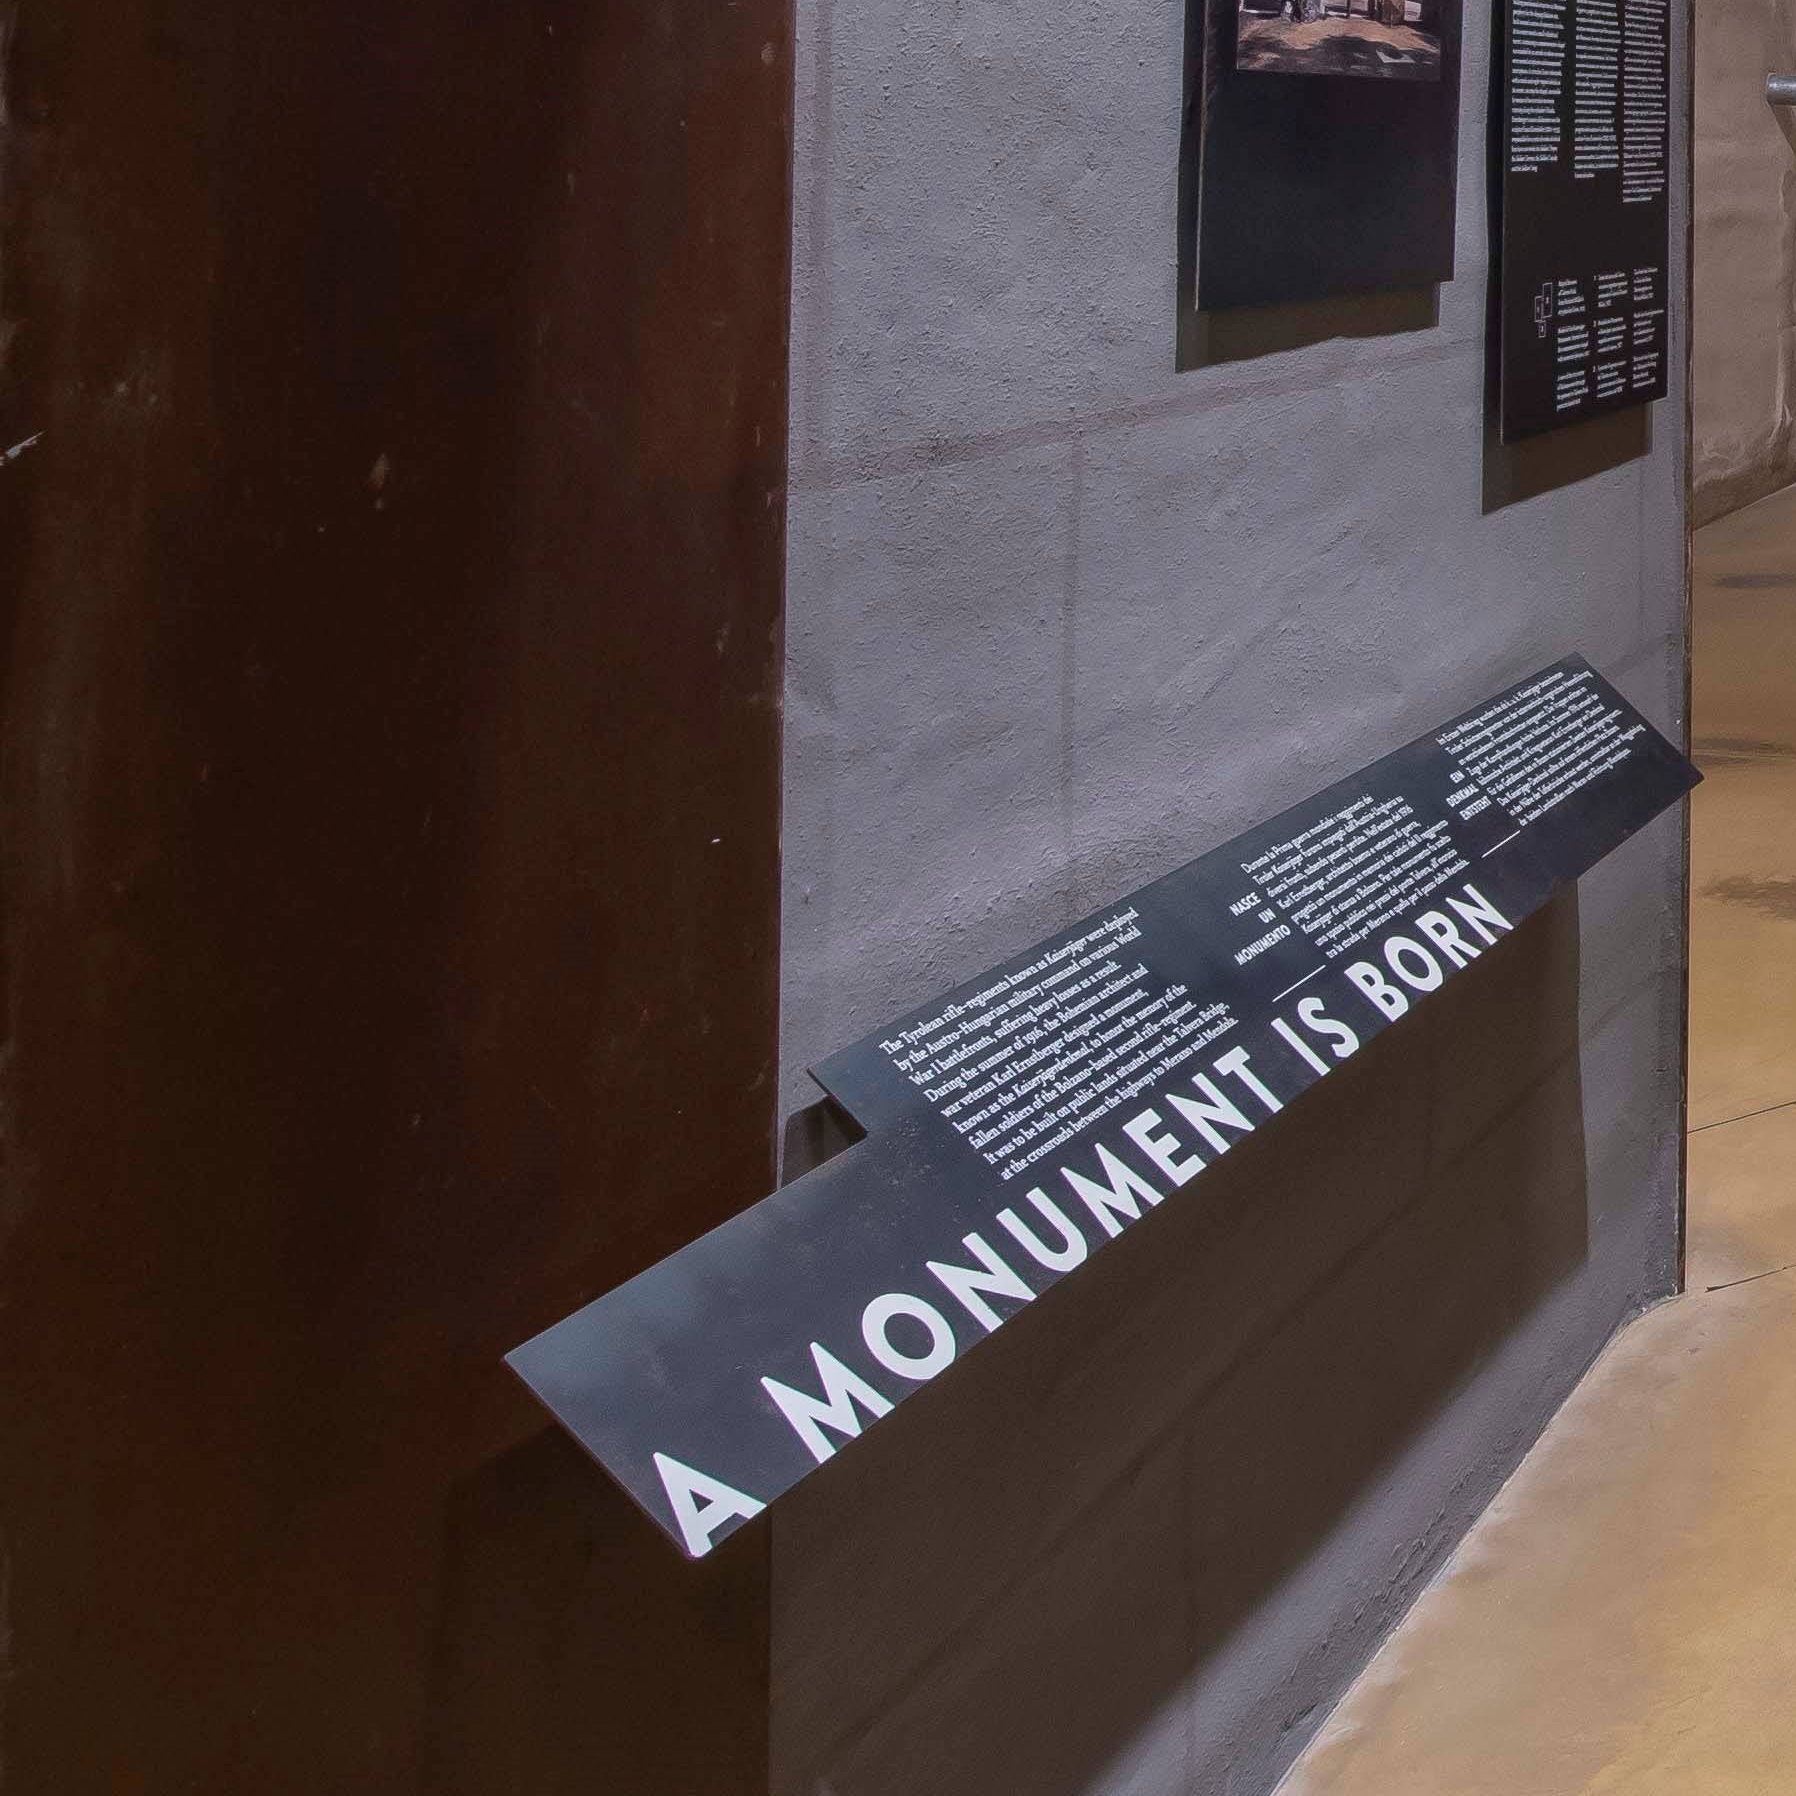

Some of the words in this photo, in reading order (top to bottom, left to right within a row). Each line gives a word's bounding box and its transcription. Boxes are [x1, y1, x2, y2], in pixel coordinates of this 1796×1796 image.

[1449, 770, 1465, 783] EIN
[1446, 783, 1479, 807] DENKMAL
[1459, 795, 1491, 820] ENTSTEHT
[1229, 892, 1261, 916] NASCE
[1258, 907, 1276, 923] UN
[1235, 924, 1290, 964] MONUMENTO
[1348, 883, 1514, 1022] BORN
[878, 1039, 904, 1054] The
[898, 1017, 945, 1045] Tyrolean
[942, 981, 1010, 1021] rifle-regiments
[1004, 965, 1039, 985] known
[1035, 959, 1048, 970] as
[1044, 937, 1087, 964] Kaiserjäger
[1084, 927, 1107, 941] were
[1103, 906, 1138, 931] deployed
[1088, 975, 1098, 983] a
[1094, 960, 1121, 979] result.
[1052, 984, 1081, 1002] losses
[1079, 978, 1091, 988] as
[1165, 988, 1176, 1002] of
[1171, 984, 1187, 996] the
[892, 1058, 913, 1072] by
[908, 1049, 929, 1063] the
[926, 1004, 1009, 1053] Austro-Hungarian
[1007, 984, 1044, 1008] military
[1041, 959, 1081, 988] command
[1078, 957, 1092, 967] on
[1089, 941, 1119, 960] various
[1113, 925, 1141, 944] World
[1028, 997, 1060, 1016] heavy
[1135, 997, 1169, 1020] memory
[1297, 961, 1409, 1058] IS
[923, 1076, 967, 1102] During
[960, 1067, 979, 1081] the
[977, 1046, 1014, 1071] summer
[1013, 1035, 1026, 1050] of
[1022, 1026, 1048, 1044] 1916,
[1043, 1018, 1061, 1031] the
[1056, 995, 1100, 1022] Bohemian
[1097, 974, 1134, 999] architect
[1131, 963, 1148, 979] and
[994, 1011, 1037, 1038] suffering
[1095, 1024, 1124, 1043] honor
[1121, 1015, 1138, 1028] the
[935, 1036, 997, 1070] battlefronts,
[940, 1101, 962, 1117] war
[959, 1081, 997, 1105] veteran
[991, 1064, 1017, 1085] Karl
[1011, 1038, 1064, 1072] Ernstberger
[1062, 1013, 1100, 1042] designed
[1097, 1013, 1107, 1021] a
[1103, 988, 1148, 1017] monument,
[1089, 1038, 1102, 1048] to
[908, 1069, 934, 1085] War
[929, 1060, 942, 1074] I
[968, 1127, 1000, 1149] fallen
[998, 1105, 1034, 1131] soldiers
[1032, 1093, 1045, 1109] of
[1040, 1089, 1059, 1102] the
[1054, 1048, 1117, 1093] Bolzano-based
[1115, 1031, 1144, 1055] second
[1141, 1001, 1196, 1038] rifle-regiment.
[1012, 1042, 1093, 1096] Kaiserjägerdenkmal,
[982, 1152, 998, 1164] It
[994, 1142, 1015, 1157] was
[1012, 1135, 1025, 1146] to
[1019, 1127, 1038, 1140] be
[1031, 1111, 1059, 1132] built
[1056, 1106, 1071, 1117] on
[1067, 1088, 1096, 1114] public
[1090, 1073, 1118, 1093] lands
[1116, 1050, 1149, 1078] situated
[1145, 1042, 1165, 1058] near
[1162, 1034, 1178, 1046] the
[1172, 1018, 1204, 1038] Talvera
[1198, 1003, 1229, 1021] Bridge,
[987, 1102, 1001, 1113] as
[997, 1092, 1016, 1106] the
[1000, 1167, 1014, 1180] at
[1010, 1158, 1029, 1173] the
[1027, 1127, 1074, 1162] crossroads
[1067, 1104, 1108, 1132] between
[1104, 1095, 1122, 1108] the
[1115, 1072, 1156, 1099] highways
[1152, 1066, 1165, 1076] to
[1160, 1047, 1193, 1070] Merano
[1190, 1033, 1207, 1051] and
[1202, 1017, 1238, 1041] Mendola.
[952, 1109, 990, 1133] known
[760, 1045, 1284, 1464] MONUMENT
[652, 1451, 767, 1558] A
